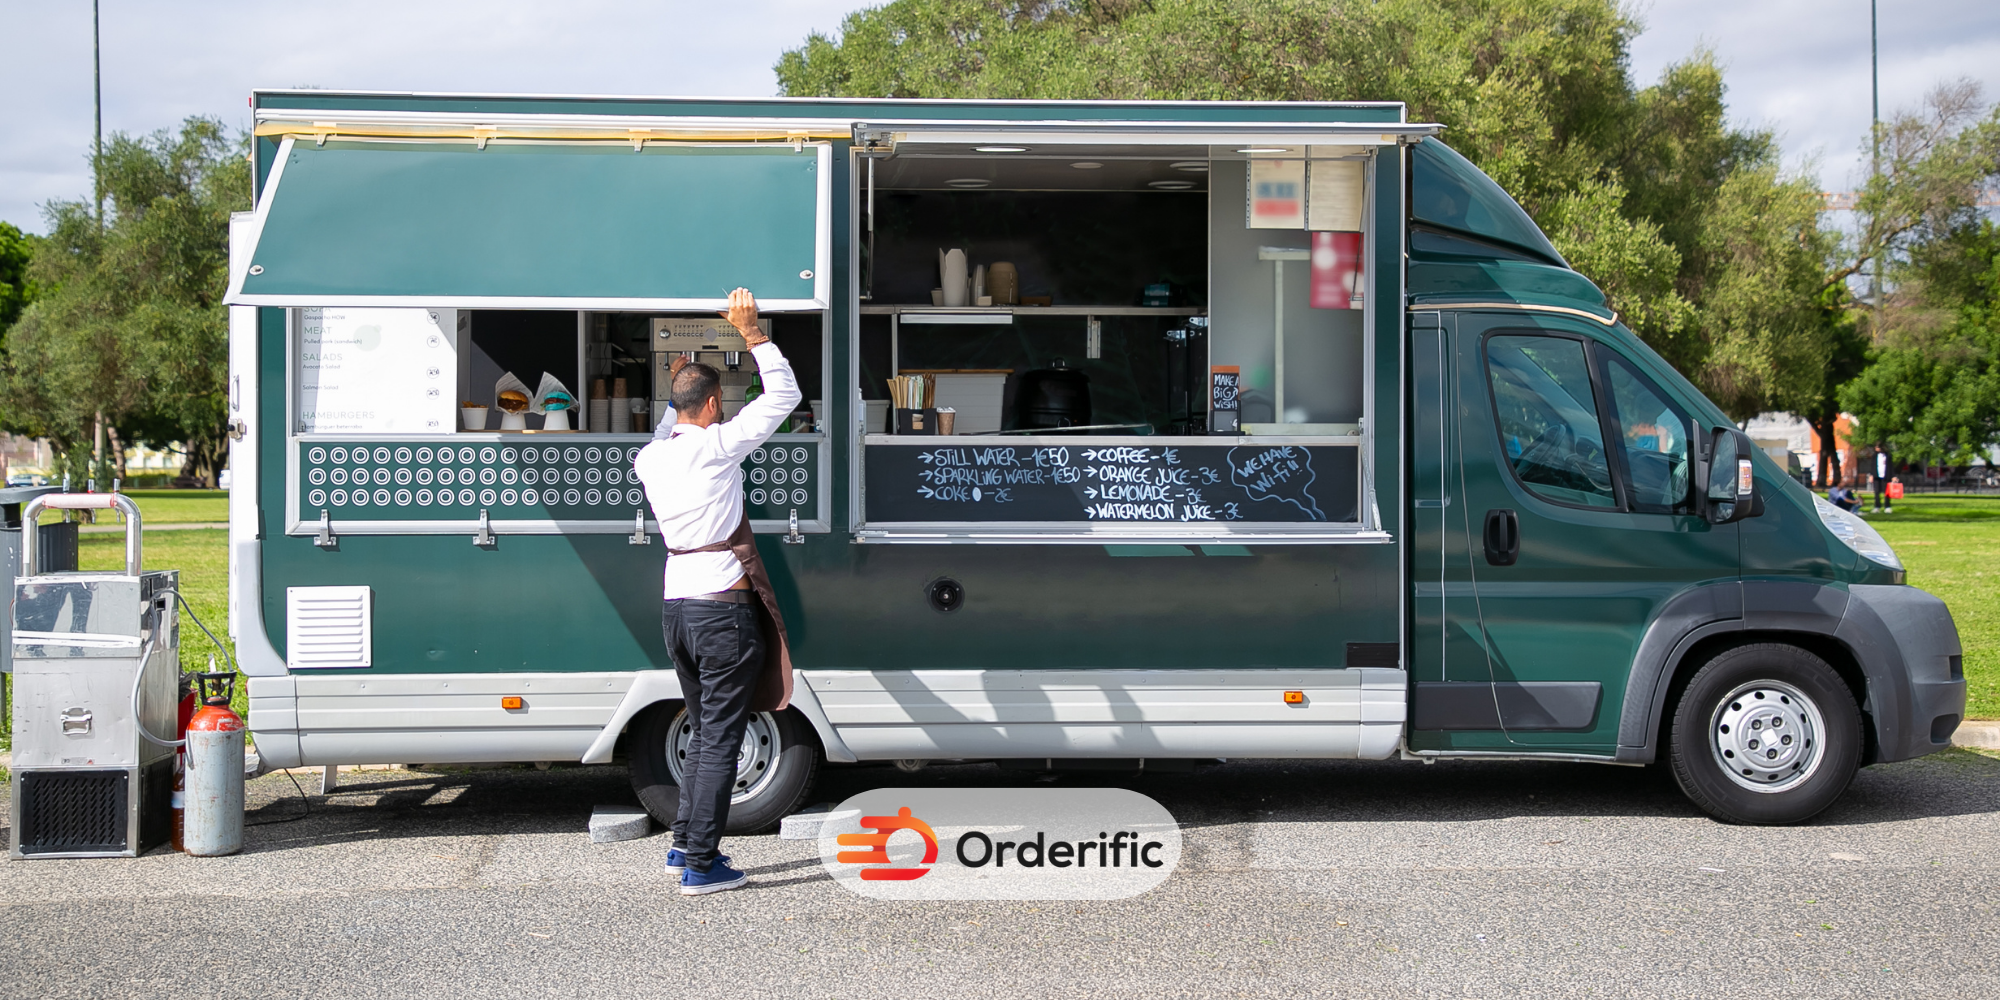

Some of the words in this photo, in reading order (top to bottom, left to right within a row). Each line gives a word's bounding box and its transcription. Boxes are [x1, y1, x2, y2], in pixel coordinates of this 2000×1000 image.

[303, 326, 332, 335] MEAT
[302, 353, 343, 361] SALADS
[1214, 374, 1234, 386] MAKE
[302, 411, 375, 420] HAMBURGERS
[972, 447, 1021, 467] WATER
[1097, 447, 1150, 465] COFFEE
[1236, 457, 1263, 478] WE
[1259, 445, 1297, 466] HAVE
[1003, 468, 1045, 484] WATER
[1099, 465, 1152, 484] ORANGE
[934, 486, 970, 503] COKE
[1100, 484, 1175, 503] LEMONADE
[1095, 501, 1175, 520] WATERMELON
